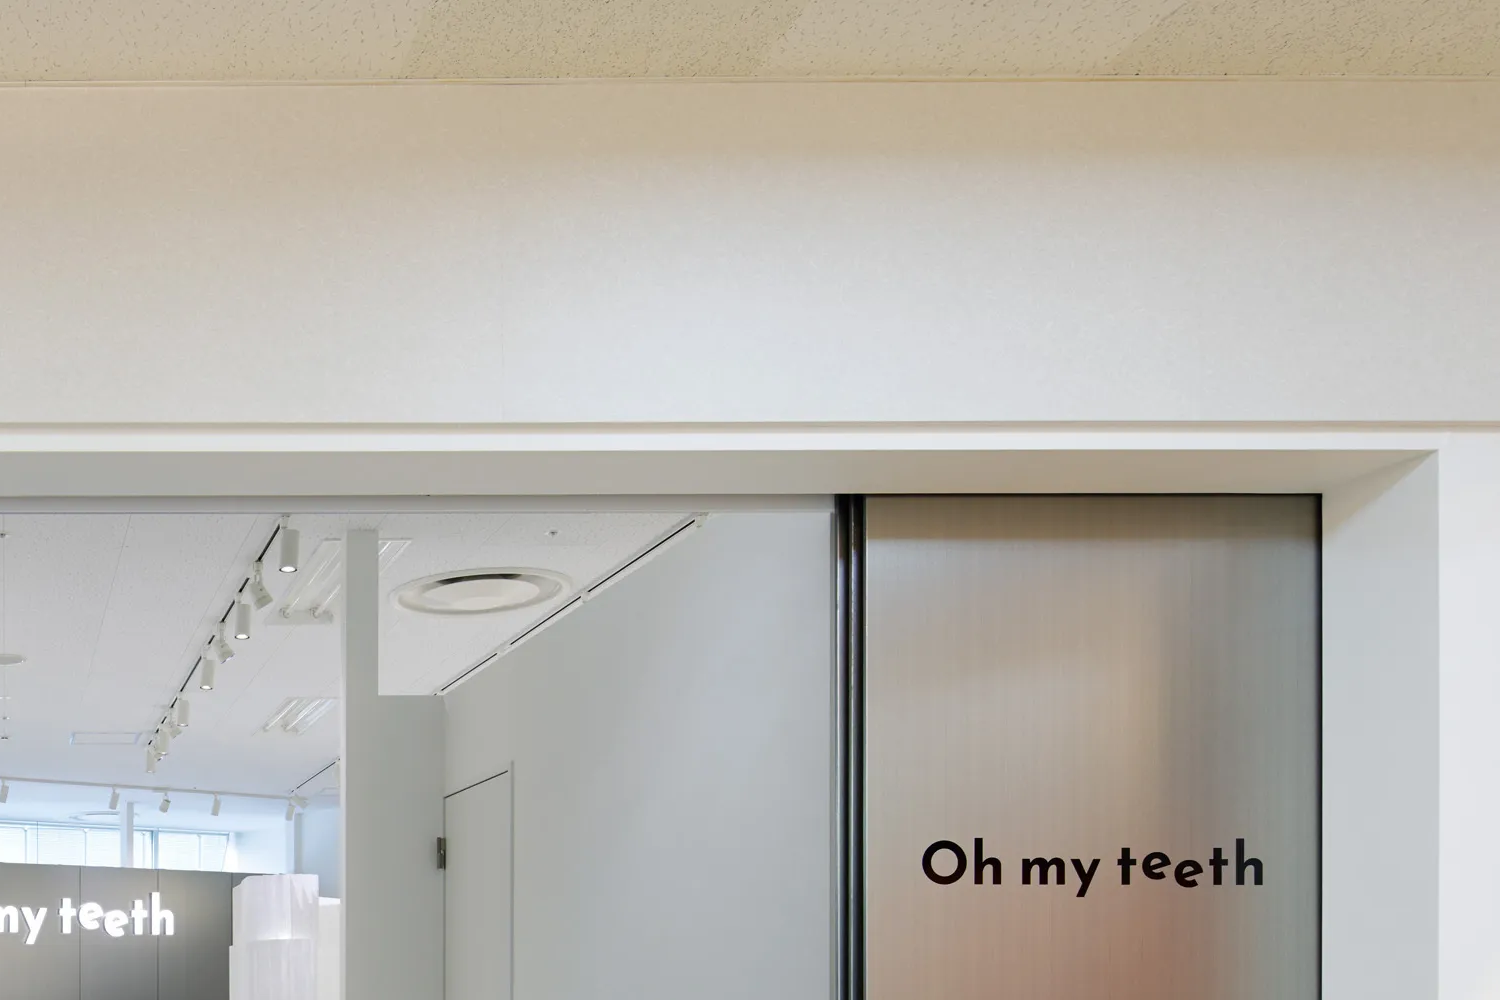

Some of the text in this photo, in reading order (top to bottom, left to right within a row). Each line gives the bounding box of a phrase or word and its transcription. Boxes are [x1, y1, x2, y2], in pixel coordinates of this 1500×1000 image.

[921, 837, 1264, 898] Oh my teeth
[57, 891, 176, 938] teeth
